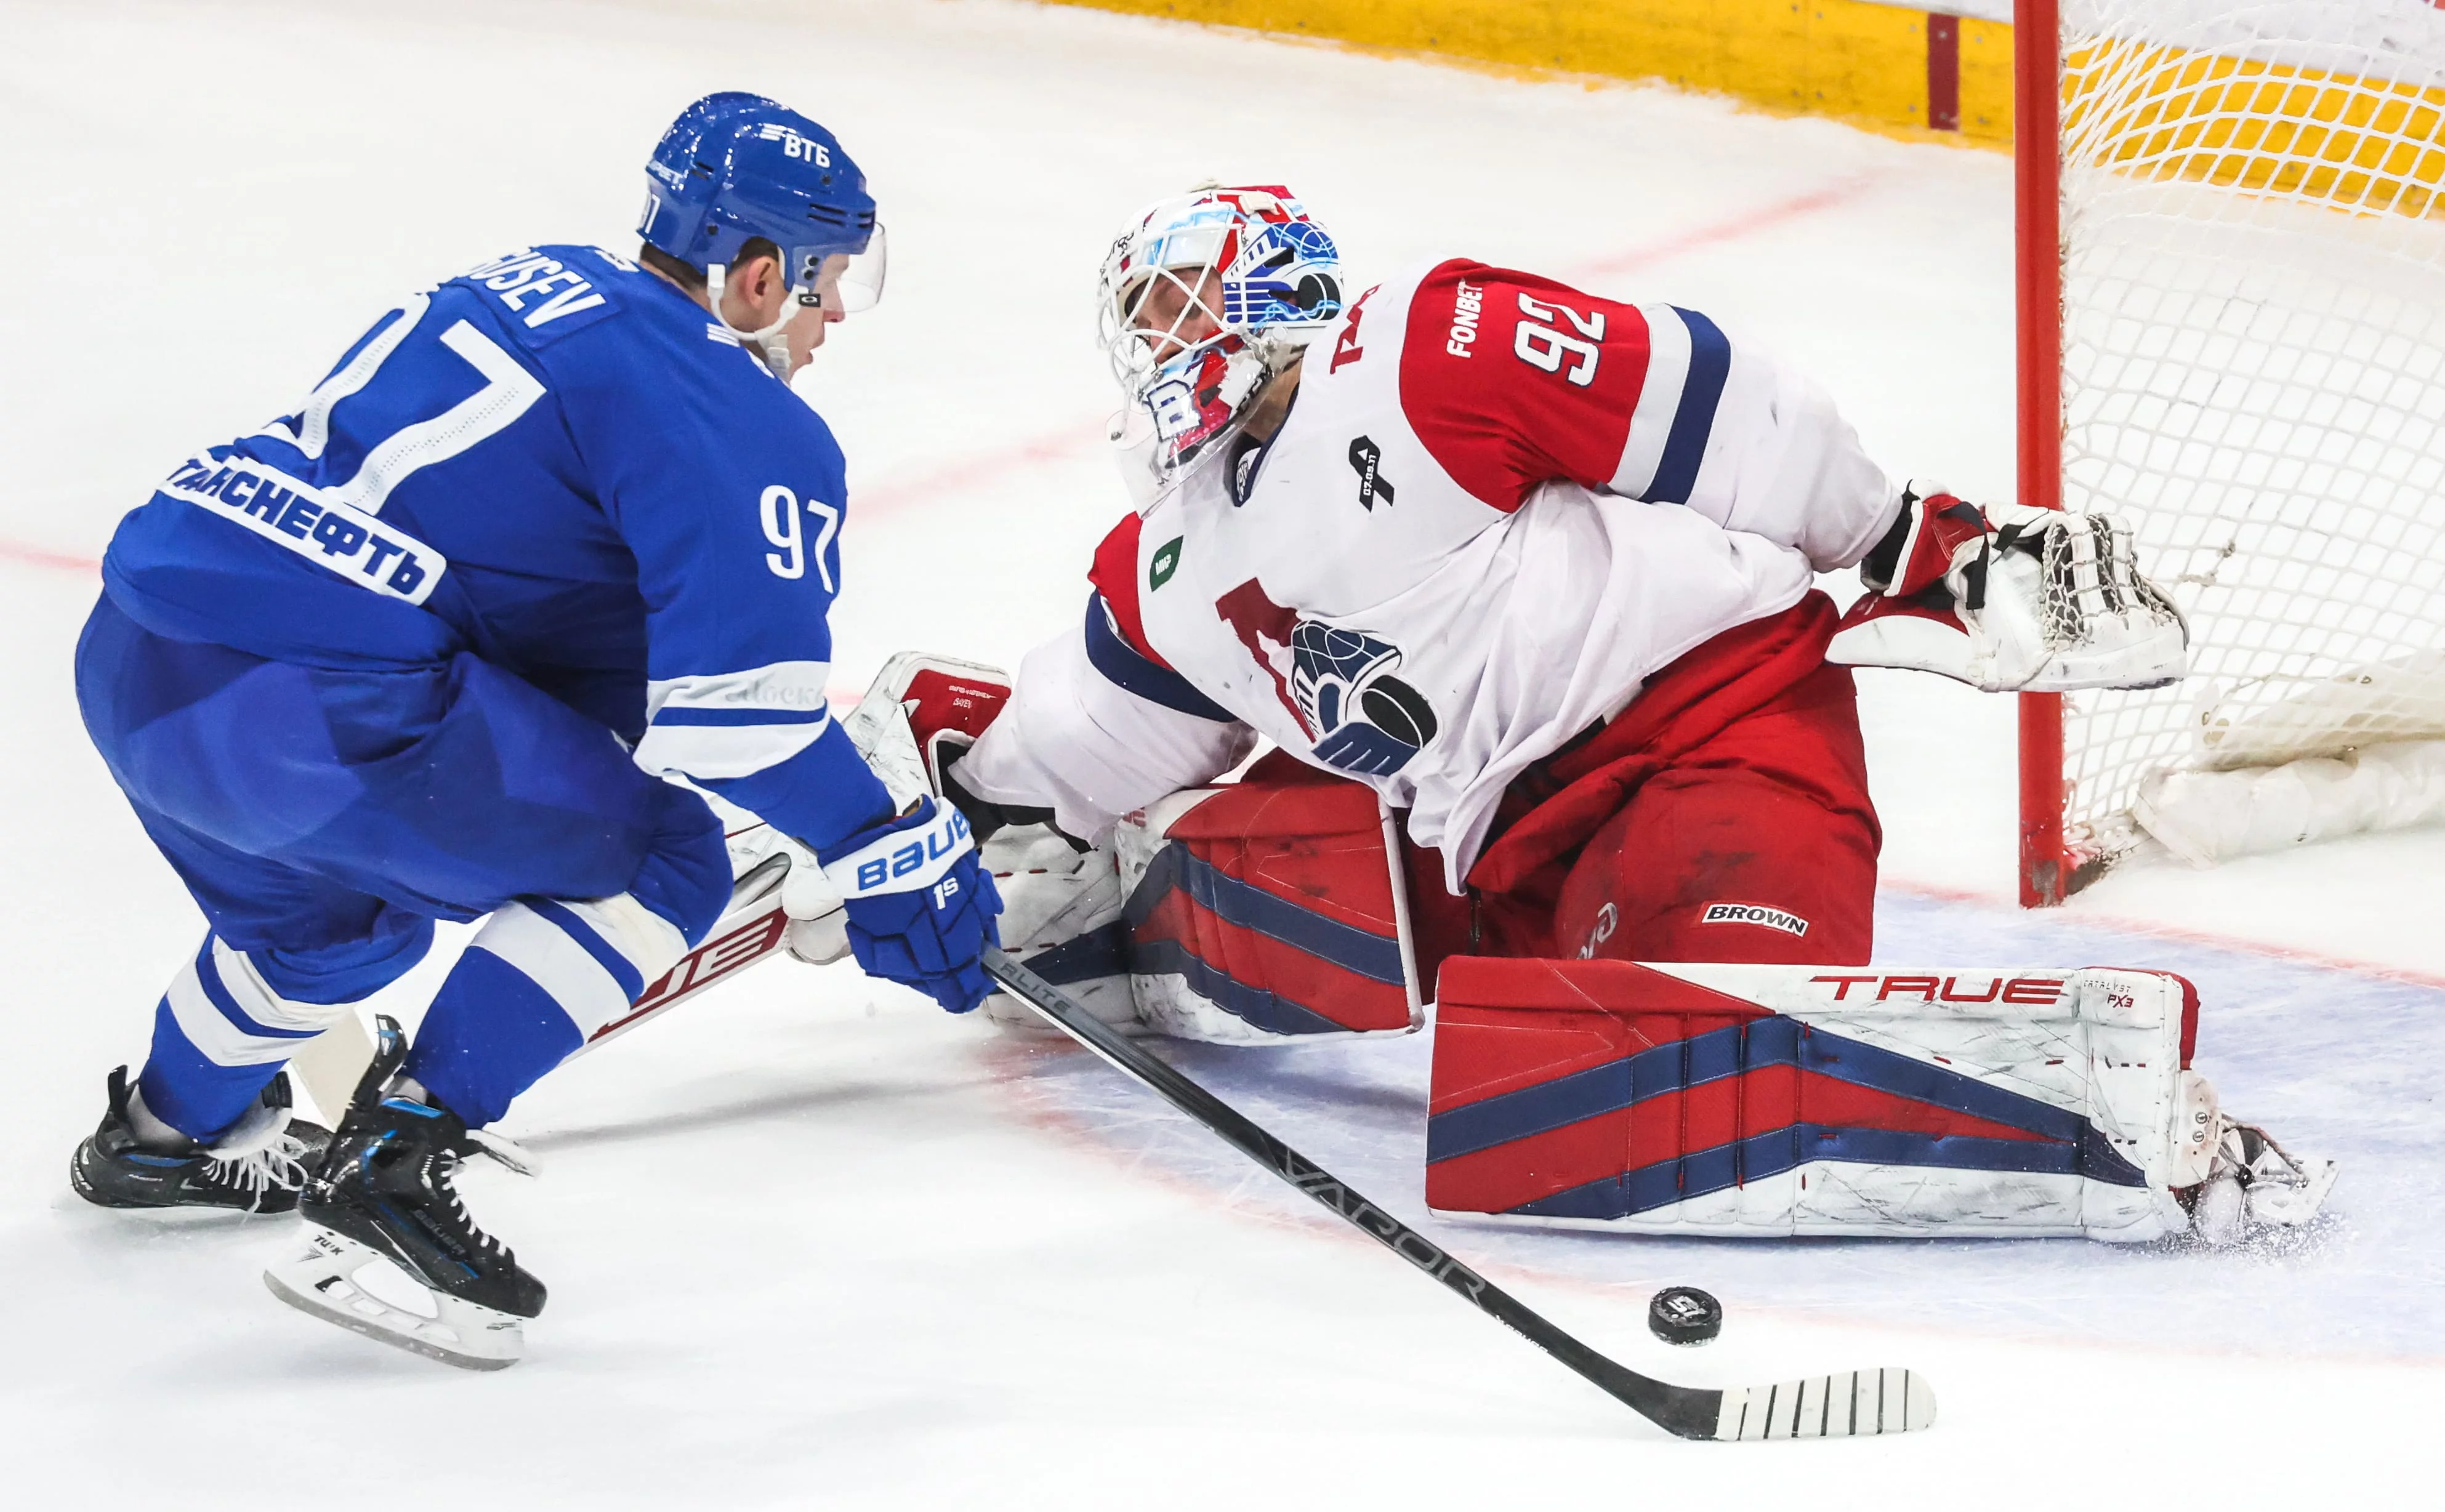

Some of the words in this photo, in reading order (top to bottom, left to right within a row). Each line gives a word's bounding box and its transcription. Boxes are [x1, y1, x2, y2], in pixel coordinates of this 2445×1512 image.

[784, 132, 831, 169] ВТБ
[467, 246, 606, 329] USEV
[1446, 278, 1483, 358] FONBET
[1513, 292, 1606, 388] 92
[1363, 454, 1377, 496] 07.09.11
[759, 485, 839, 594] 97
[858, 807, 970, 891] BAUE
[1707, 906, 1805, 933] BROWN
[1809, 976, 2064, 1005] TRUE
[2106, 993, 2134, 1008] PX3
[1284, 1148, 1486, 1307] VAPOR
